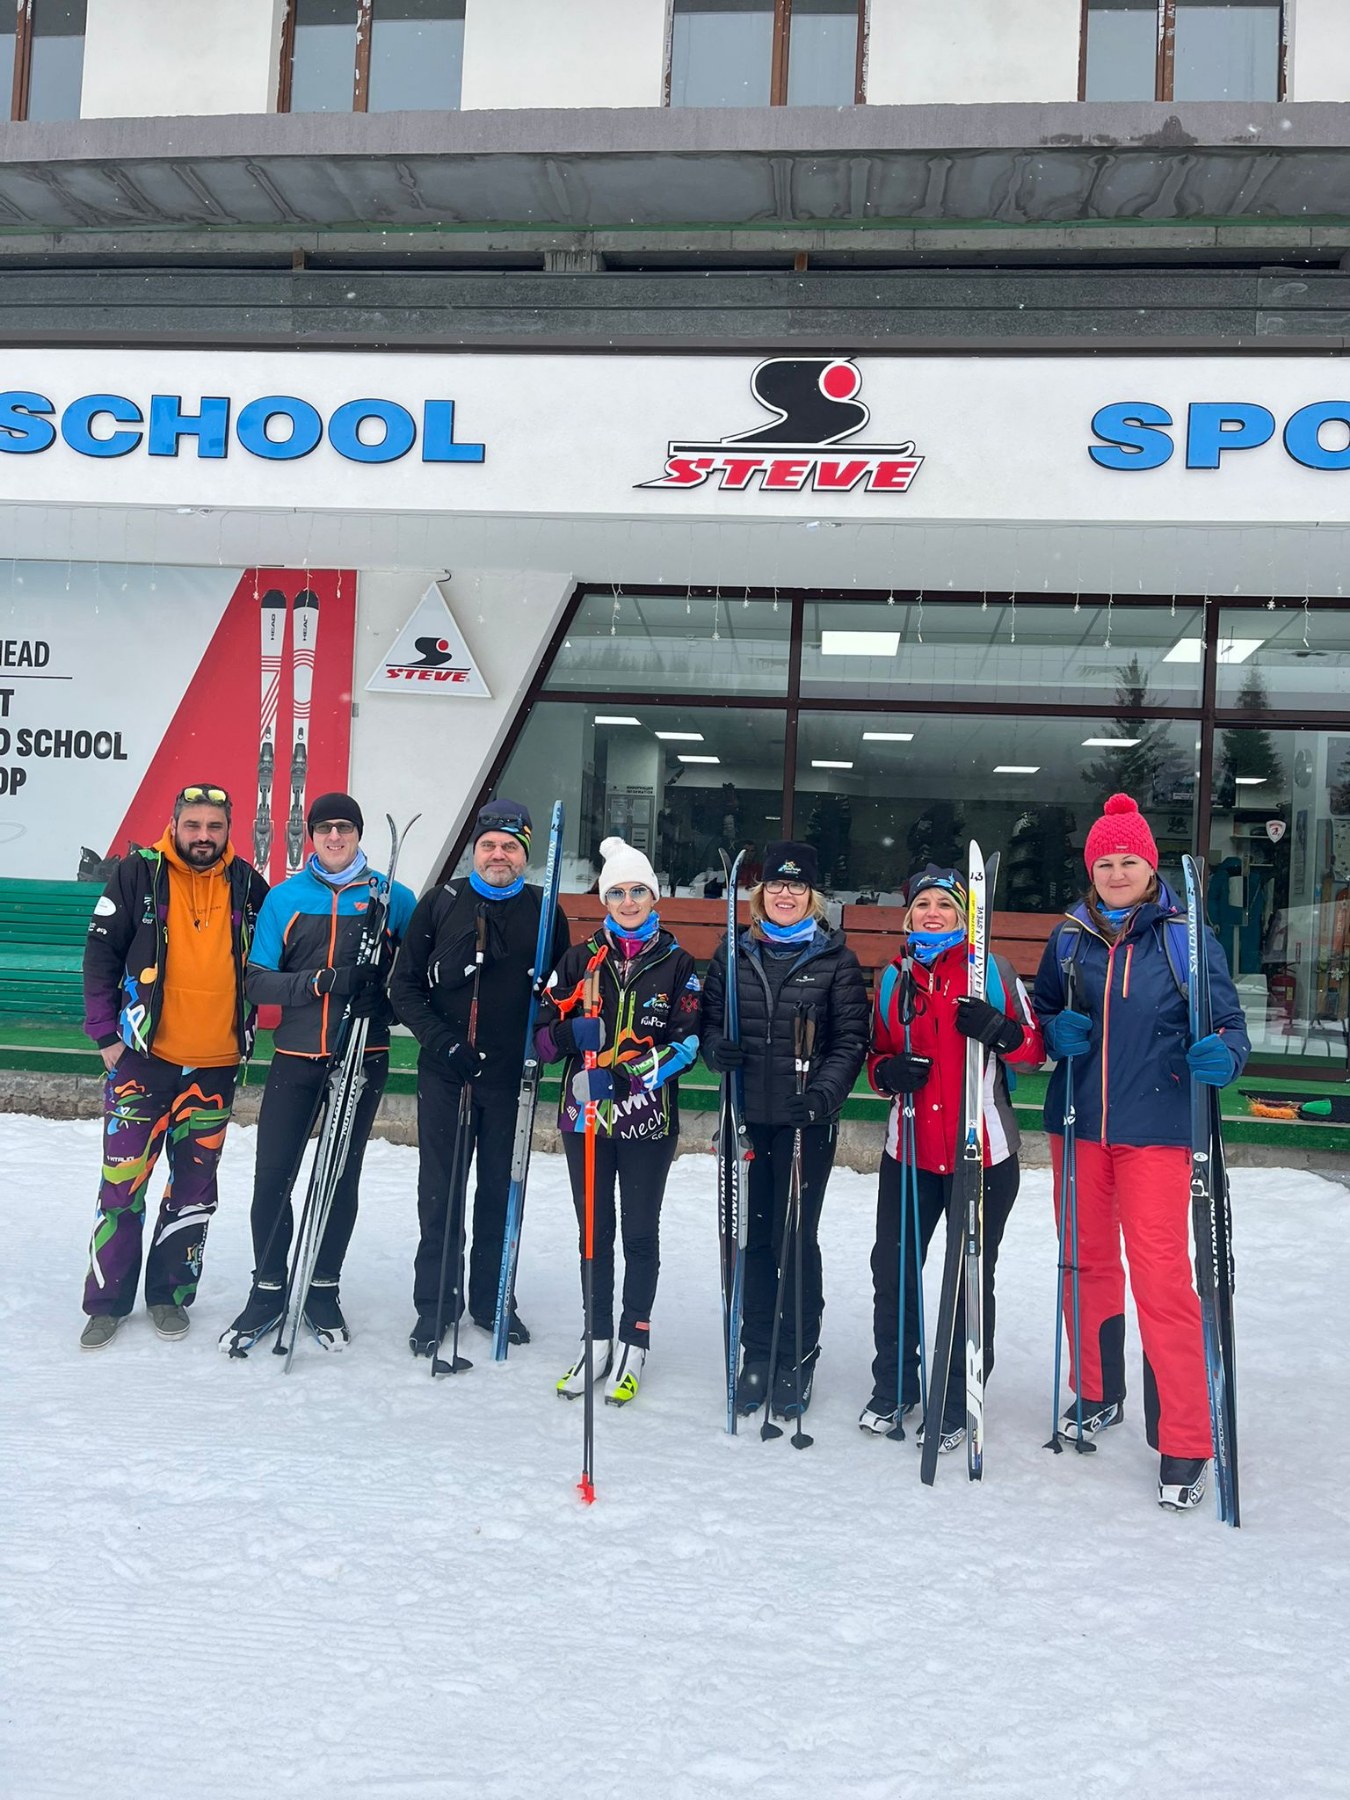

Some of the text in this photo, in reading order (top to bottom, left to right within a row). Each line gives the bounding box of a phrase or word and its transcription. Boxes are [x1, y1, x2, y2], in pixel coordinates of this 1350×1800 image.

[634, 456, 924, 492] STEVE
[0, 640, 50, 668] EAD
[385, 668, 469, 682] STEVE
[17, 728, 128, 760] SCHOOL
[543, 840, 557, 897] SALOMON
[975, 905, 984, 931] STEVE
[1187, 902, 1199, 975] SALOMON
[331, 1077, 345, 1138] SALOMON
[342, 1075, 358, 1137] SALOMON
[620, 1109, 666, 1140] Mech
[1210, 1199, 1218, 1288] SALOMON
